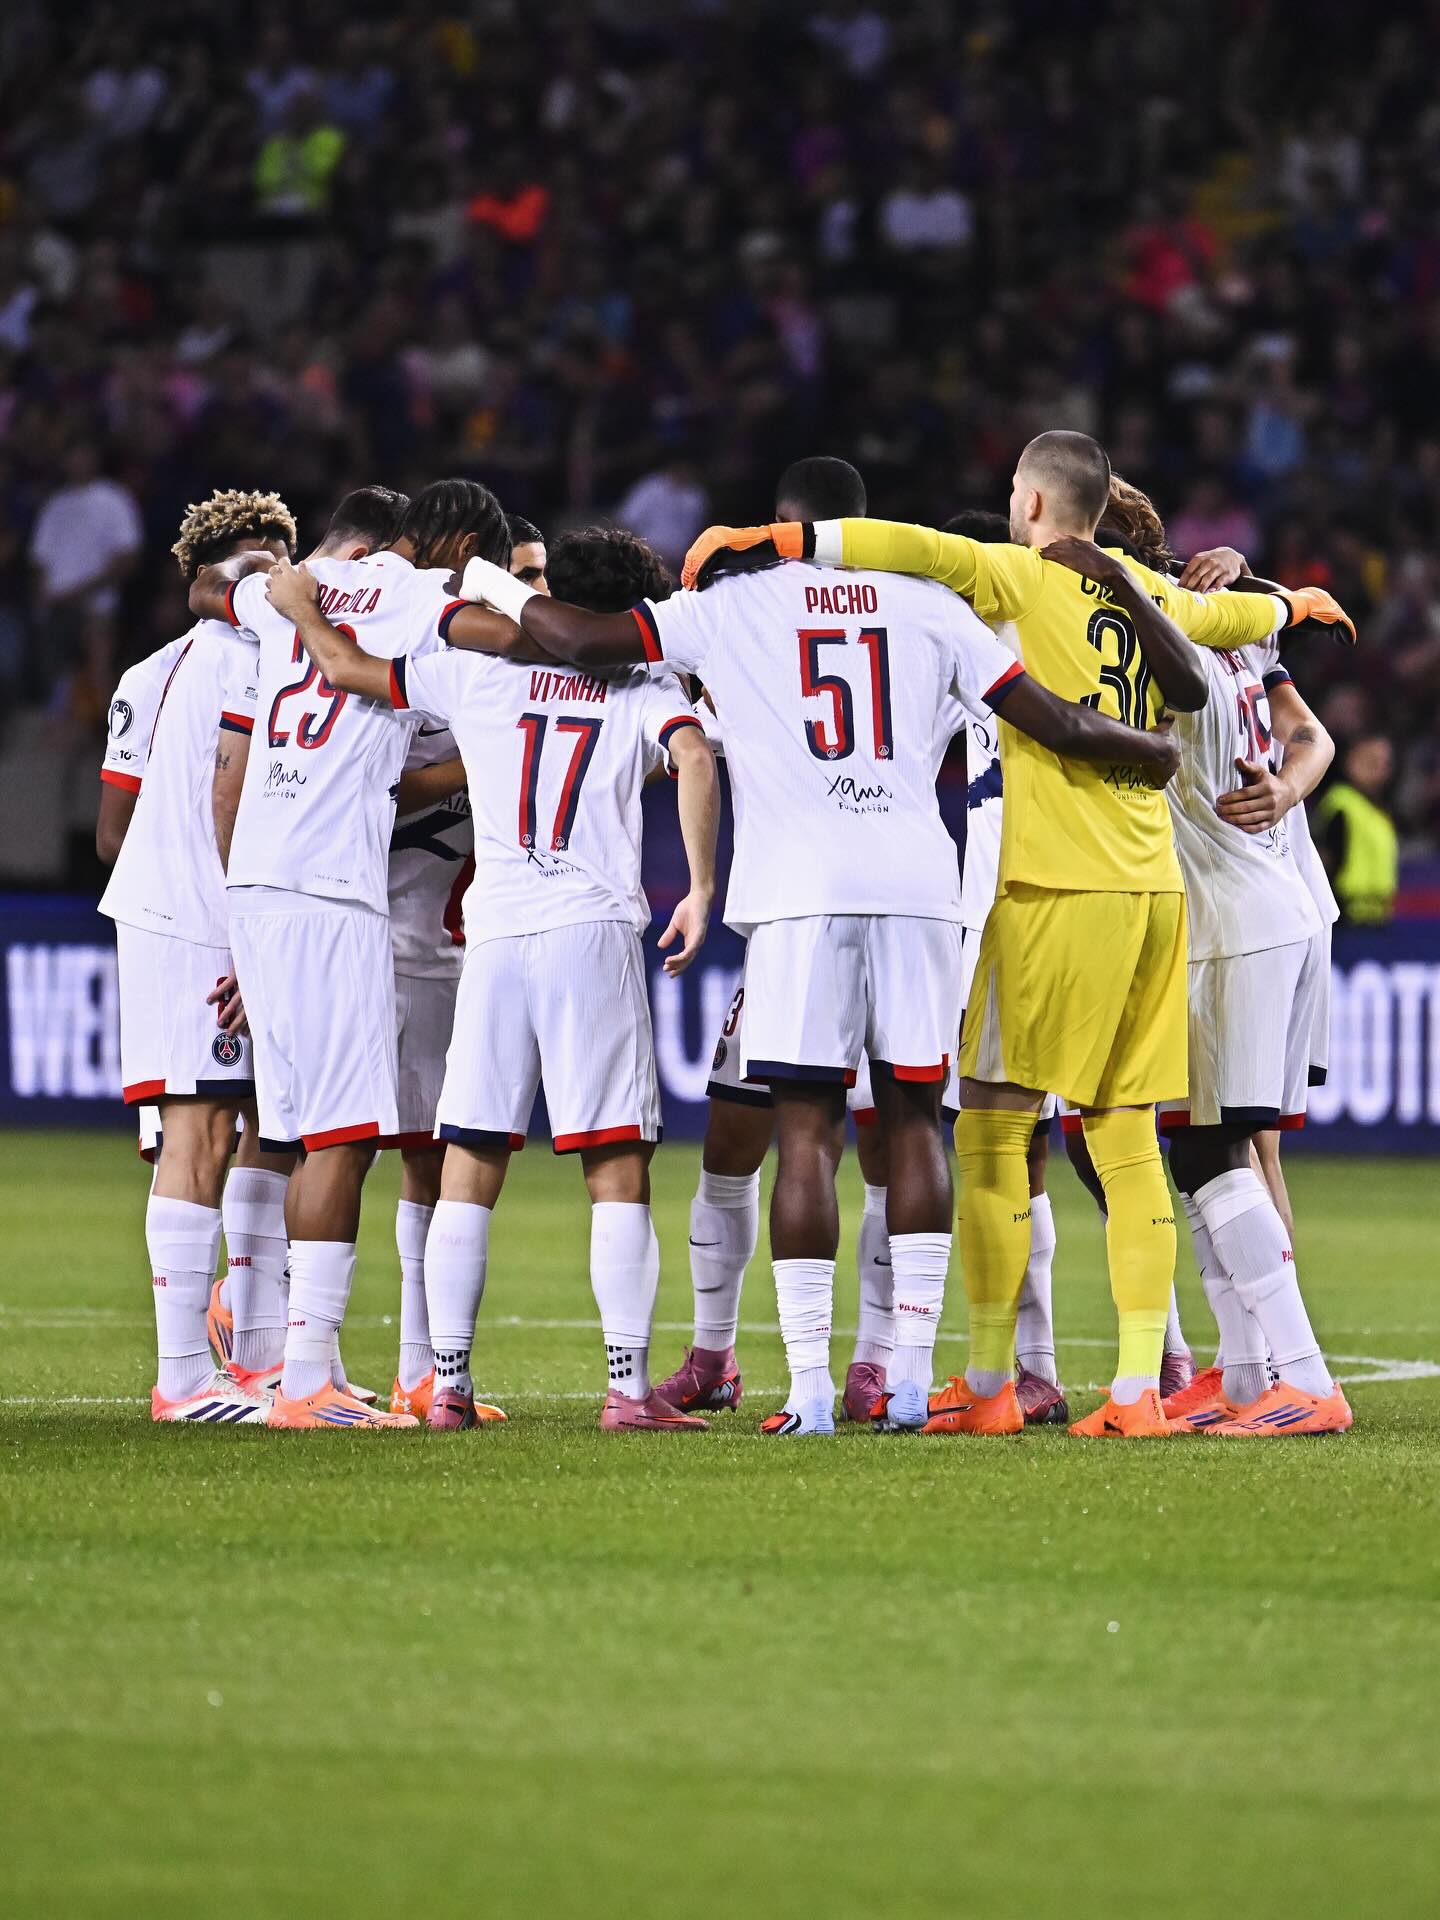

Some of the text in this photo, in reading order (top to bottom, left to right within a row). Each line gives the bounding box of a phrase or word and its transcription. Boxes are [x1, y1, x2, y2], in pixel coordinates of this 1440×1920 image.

[804, 584, 879, 615] PACHO
[268, 621, 357, 749] 29
[528, 670, 609, 703] VITINHA
[796, 627, 893, 761] 51
[516, 712, 604, 852] 17
